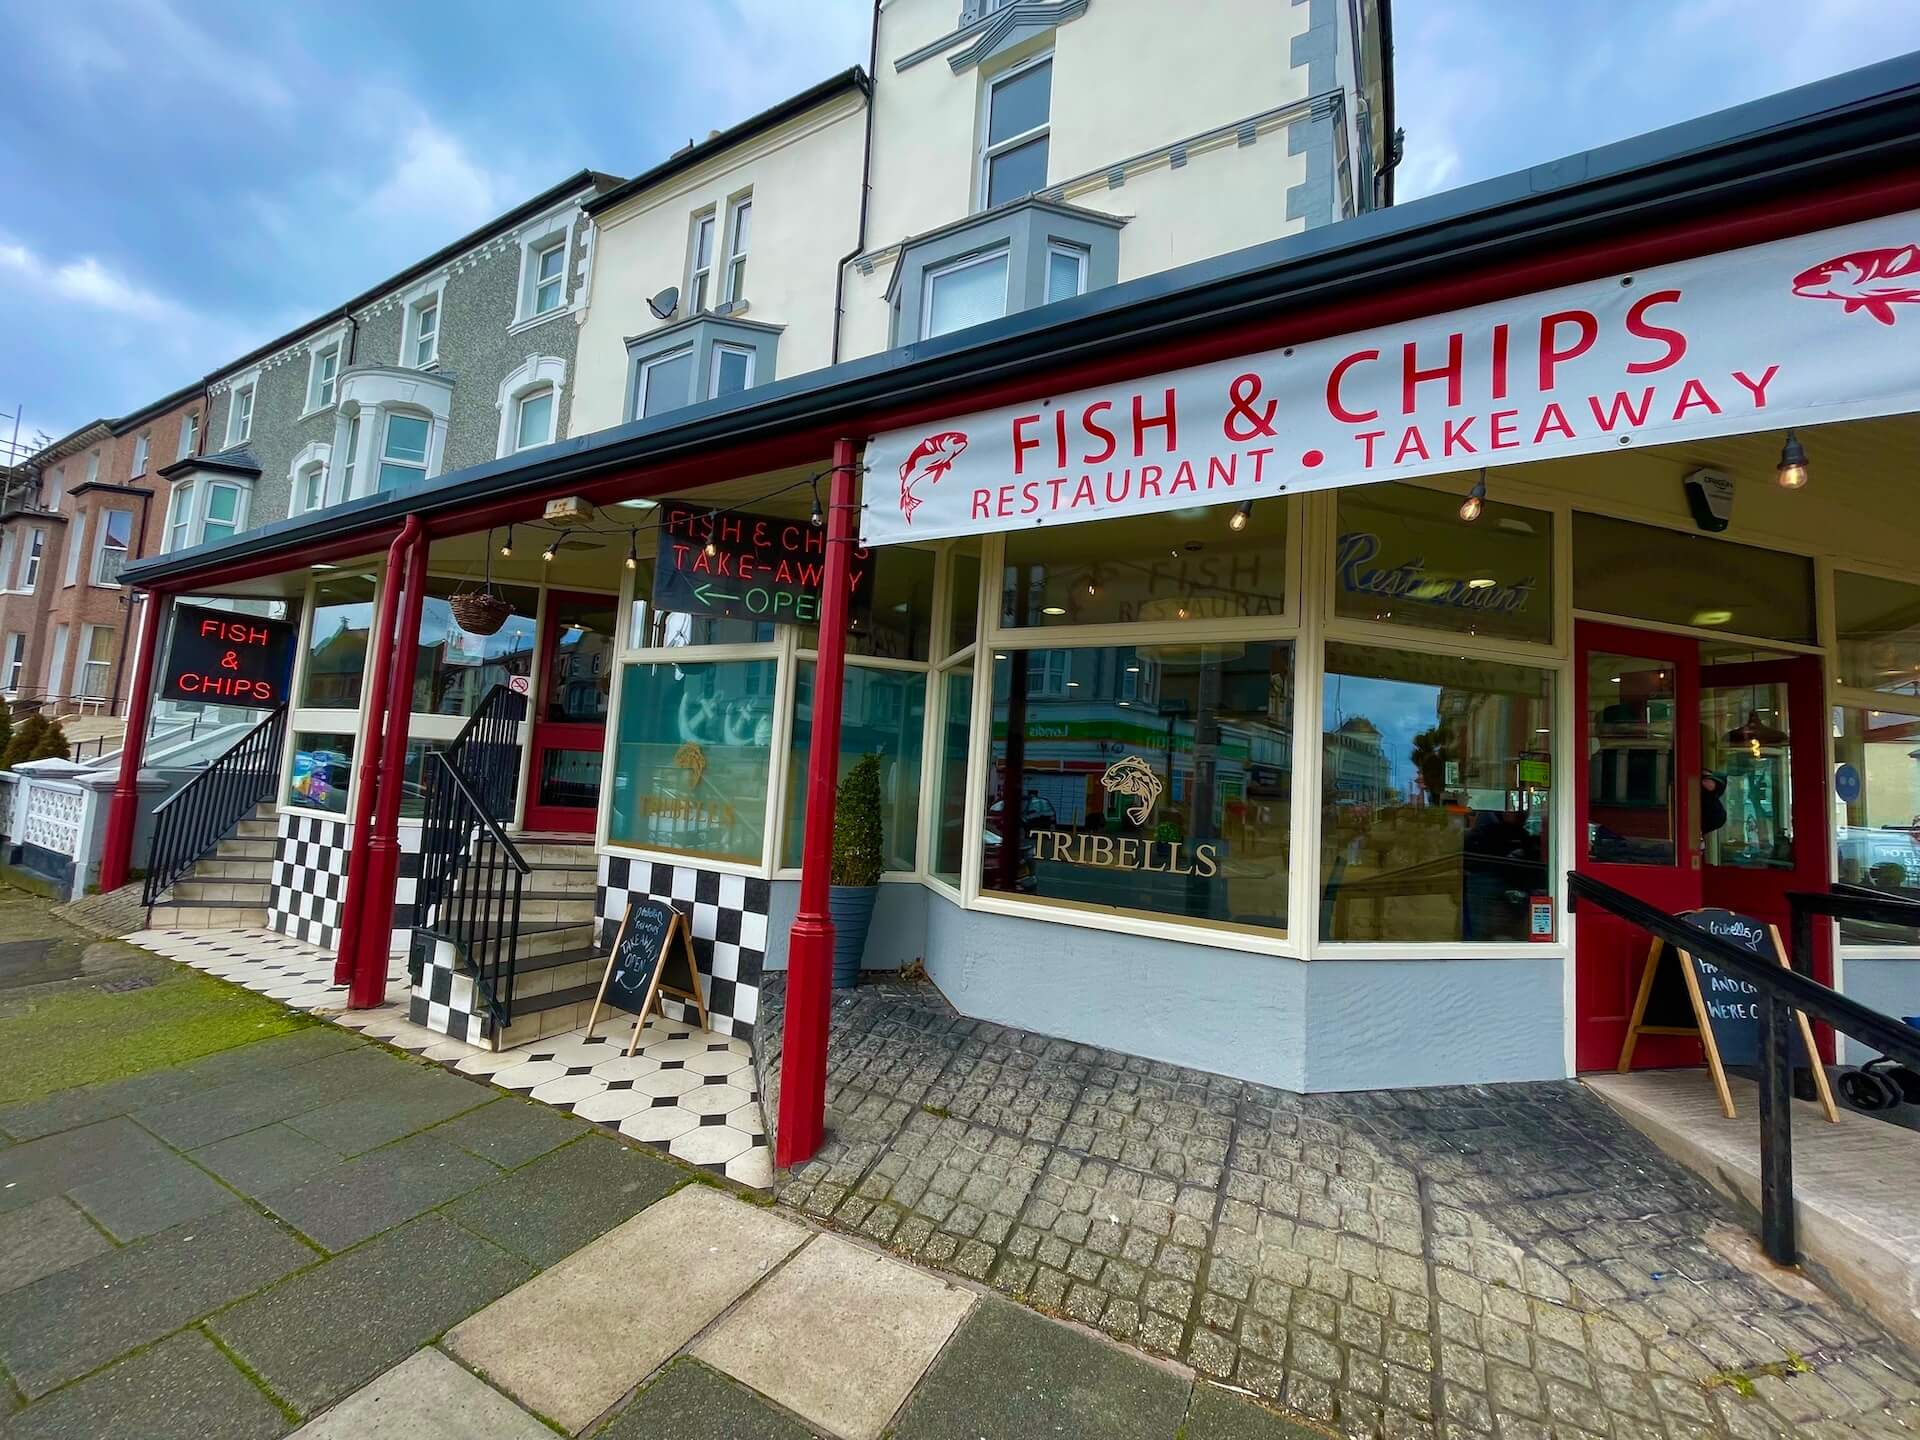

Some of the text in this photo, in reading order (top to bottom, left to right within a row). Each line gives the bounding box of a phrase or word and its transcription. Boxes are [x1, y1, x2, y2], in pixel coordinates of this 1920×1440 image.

[1012, 290, 1688, 475] FISH & CHIPS
[971, 365, 1780, 520] RESTAURANT TAKEAWAY
[669, 510, 741, 543] FISH
[672, 543, 863, 593] TAKE-AWY
[201, 620, 268, 646] FISH
[221, 650, 238, 671] &
[179, 673, 271, 700] CHIPS
[1029, 830, 1217, 878] TRIBELLS
[1711, 976, 1739, 992] AND
